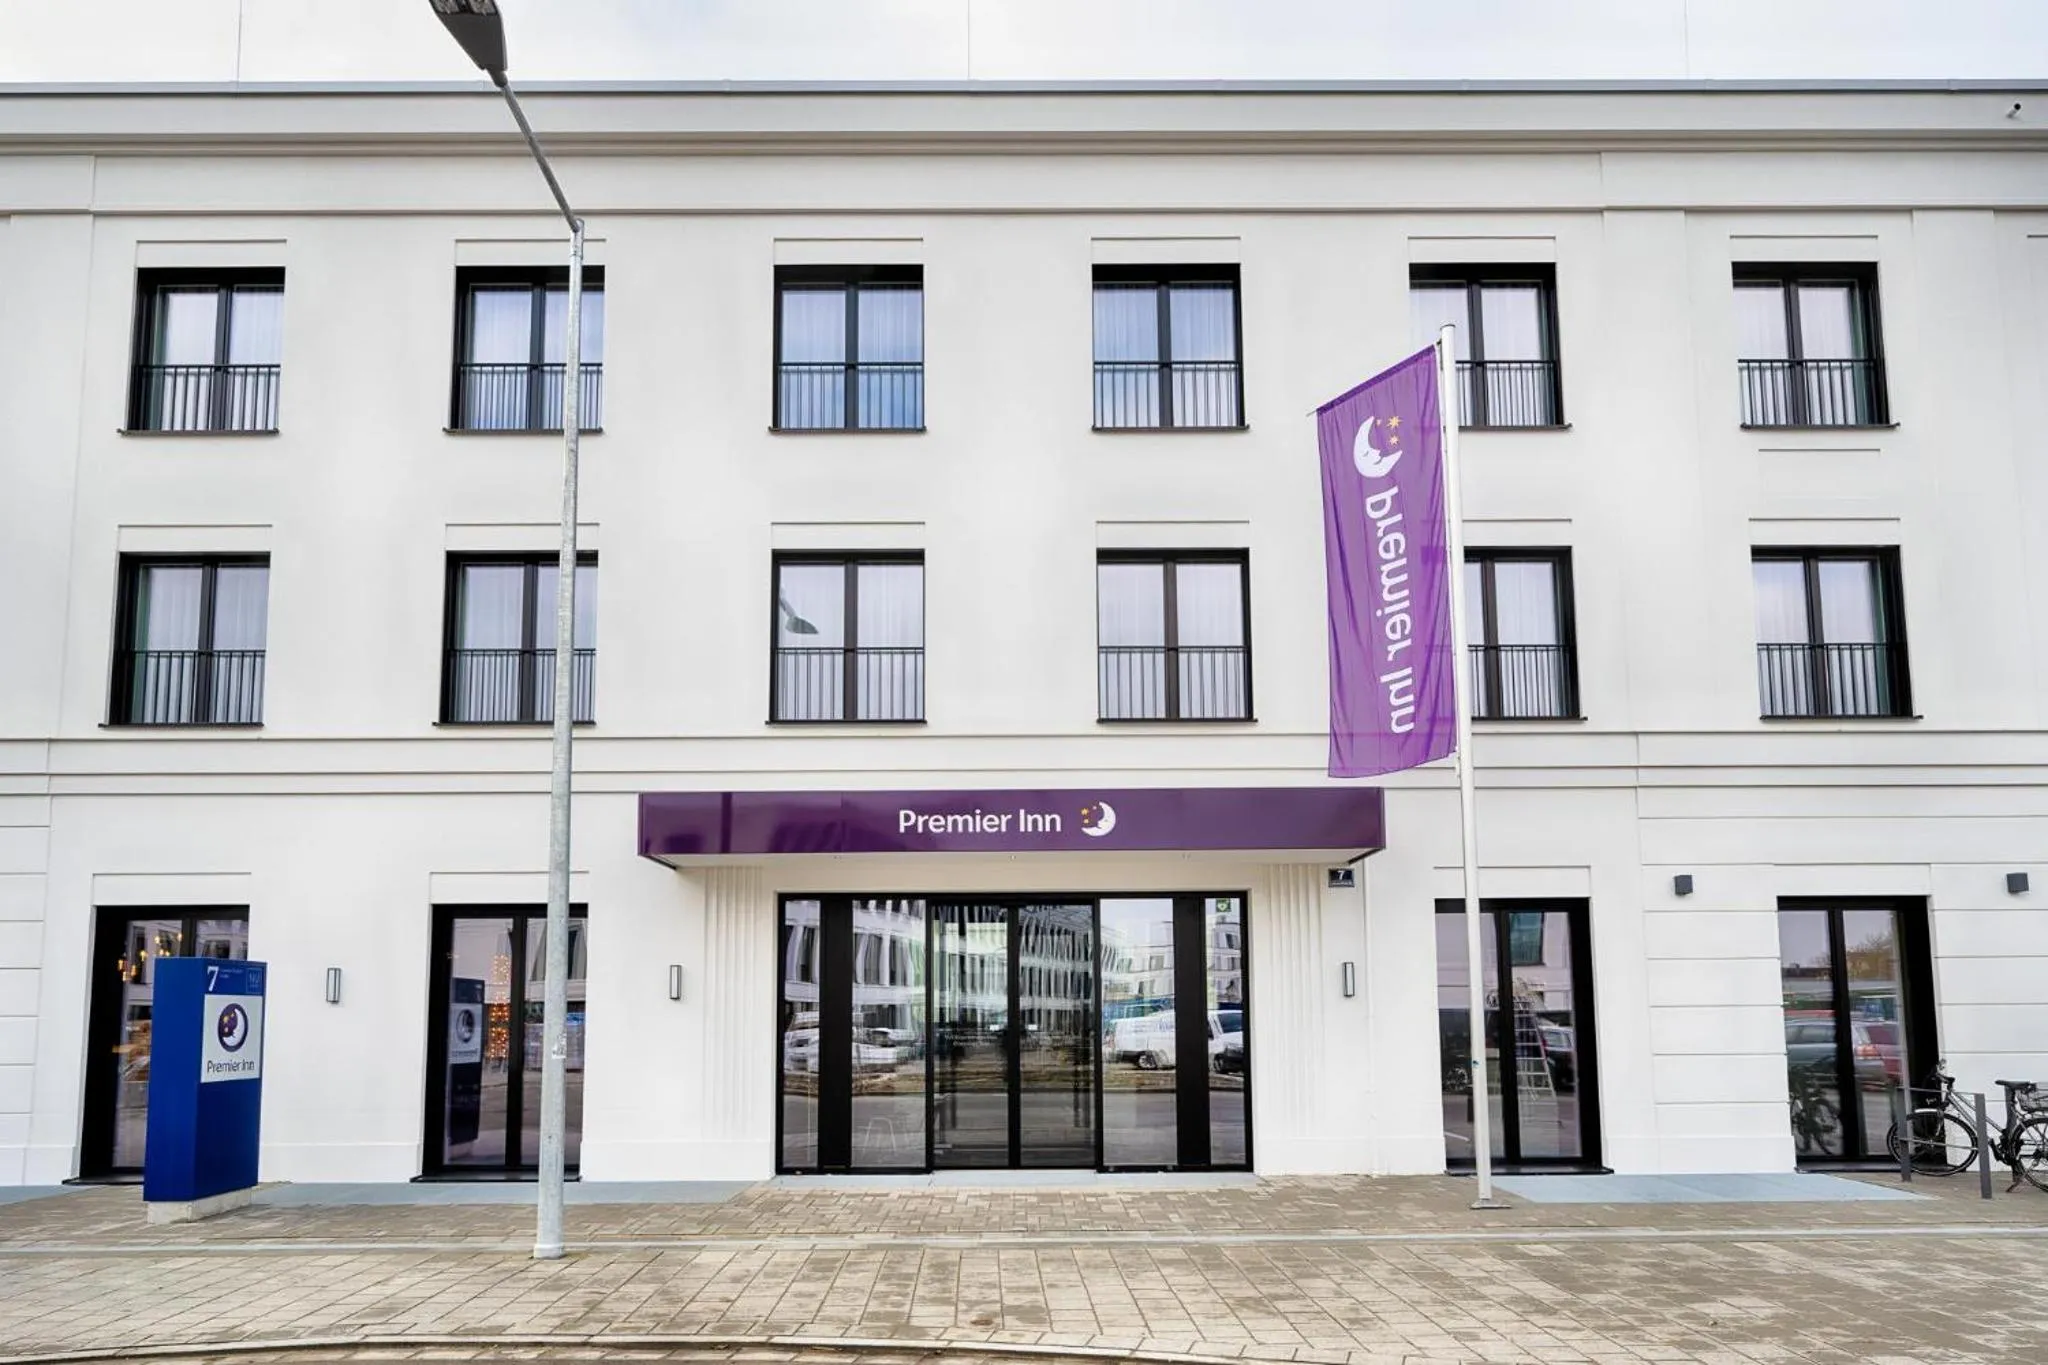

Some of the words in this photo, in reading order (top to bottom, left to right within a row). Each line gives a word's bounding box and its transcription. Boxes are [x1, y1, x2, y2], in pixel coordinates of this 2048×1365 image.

[898, 808, 1012, 833] Premier
[1019, 808, 1062, 833] Inn
[1337, 870, 1345, 880] 7
[207, 966, 219, 992] 7
[207, 1059, 241, 1073] Premier
[242, 1059, 255, 1071] Inn
